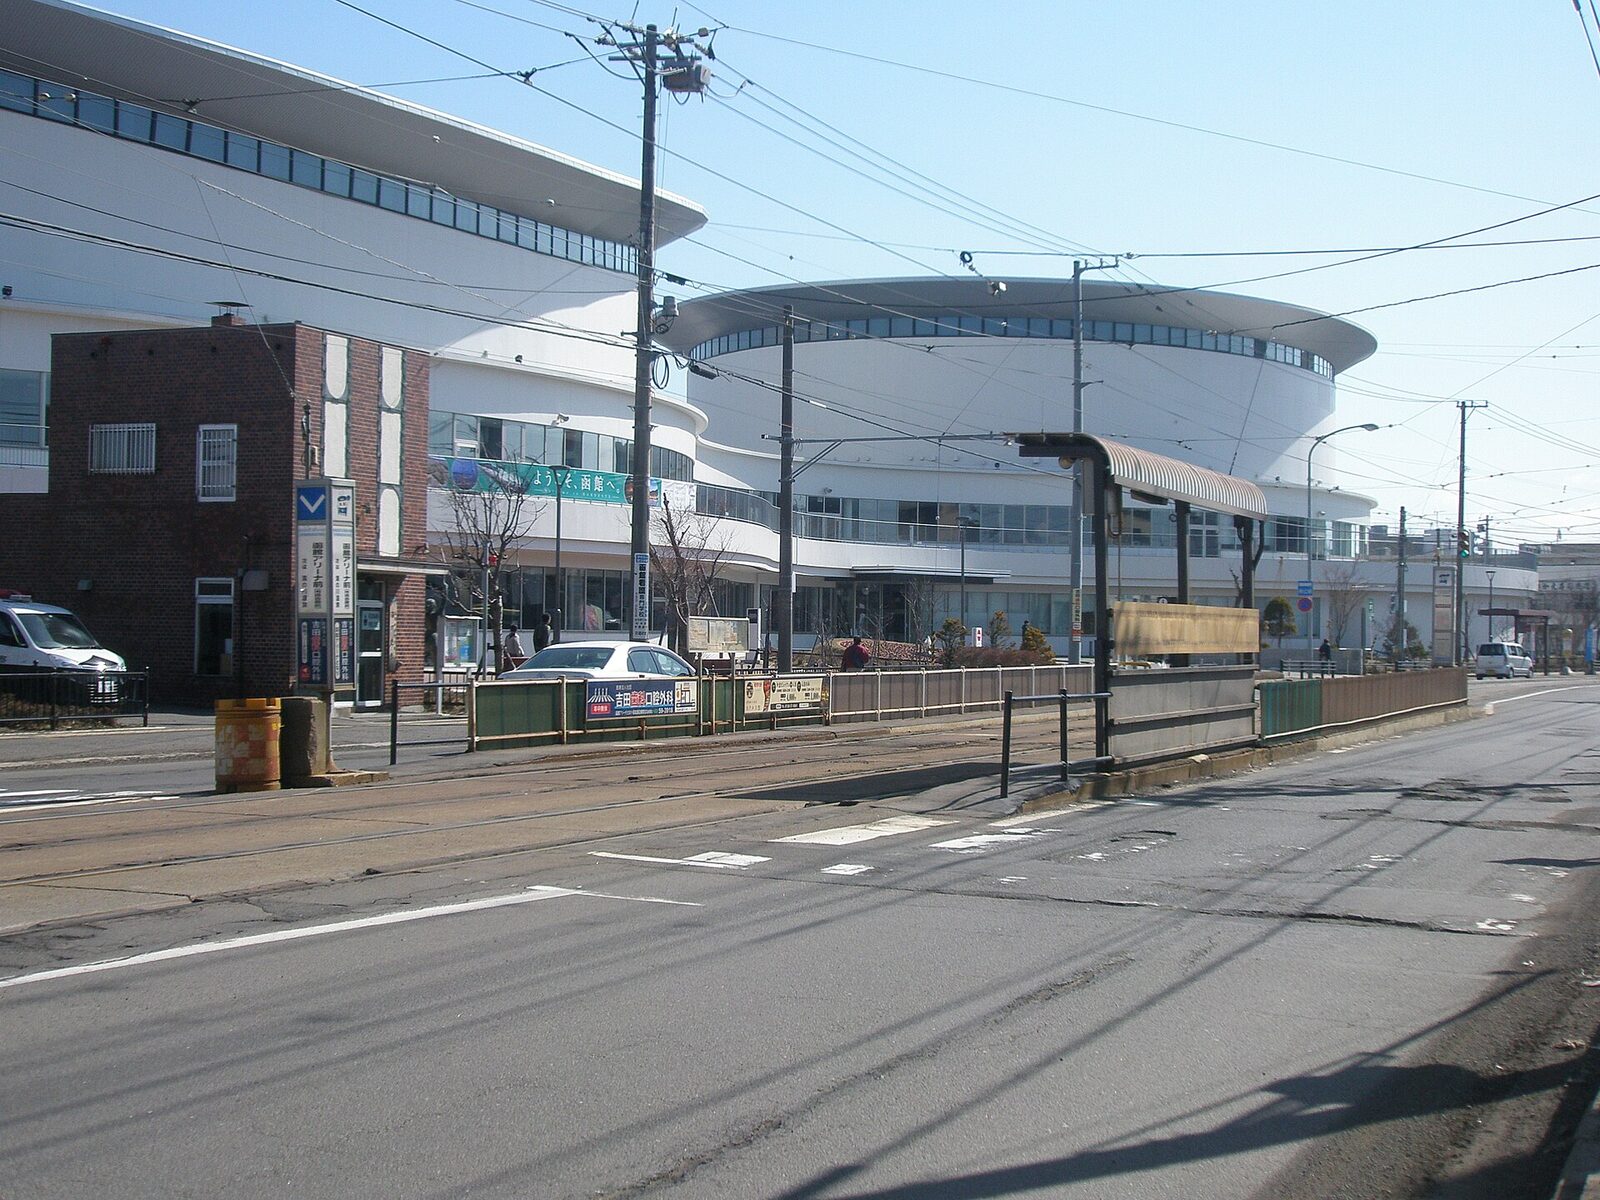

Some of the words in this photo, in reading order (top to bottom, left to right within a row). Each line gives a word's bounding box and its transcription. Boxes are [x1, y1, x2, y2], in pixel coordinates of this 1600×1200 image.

[533, 470, 620, 494] ようこそ、函館へ。
[312, 542, 324, 588] 函館アリーナ前
[342, 542, 351, 588] 函館アリーナ前
[615, 690, 673, 707] 吉田歯科口腔外科
